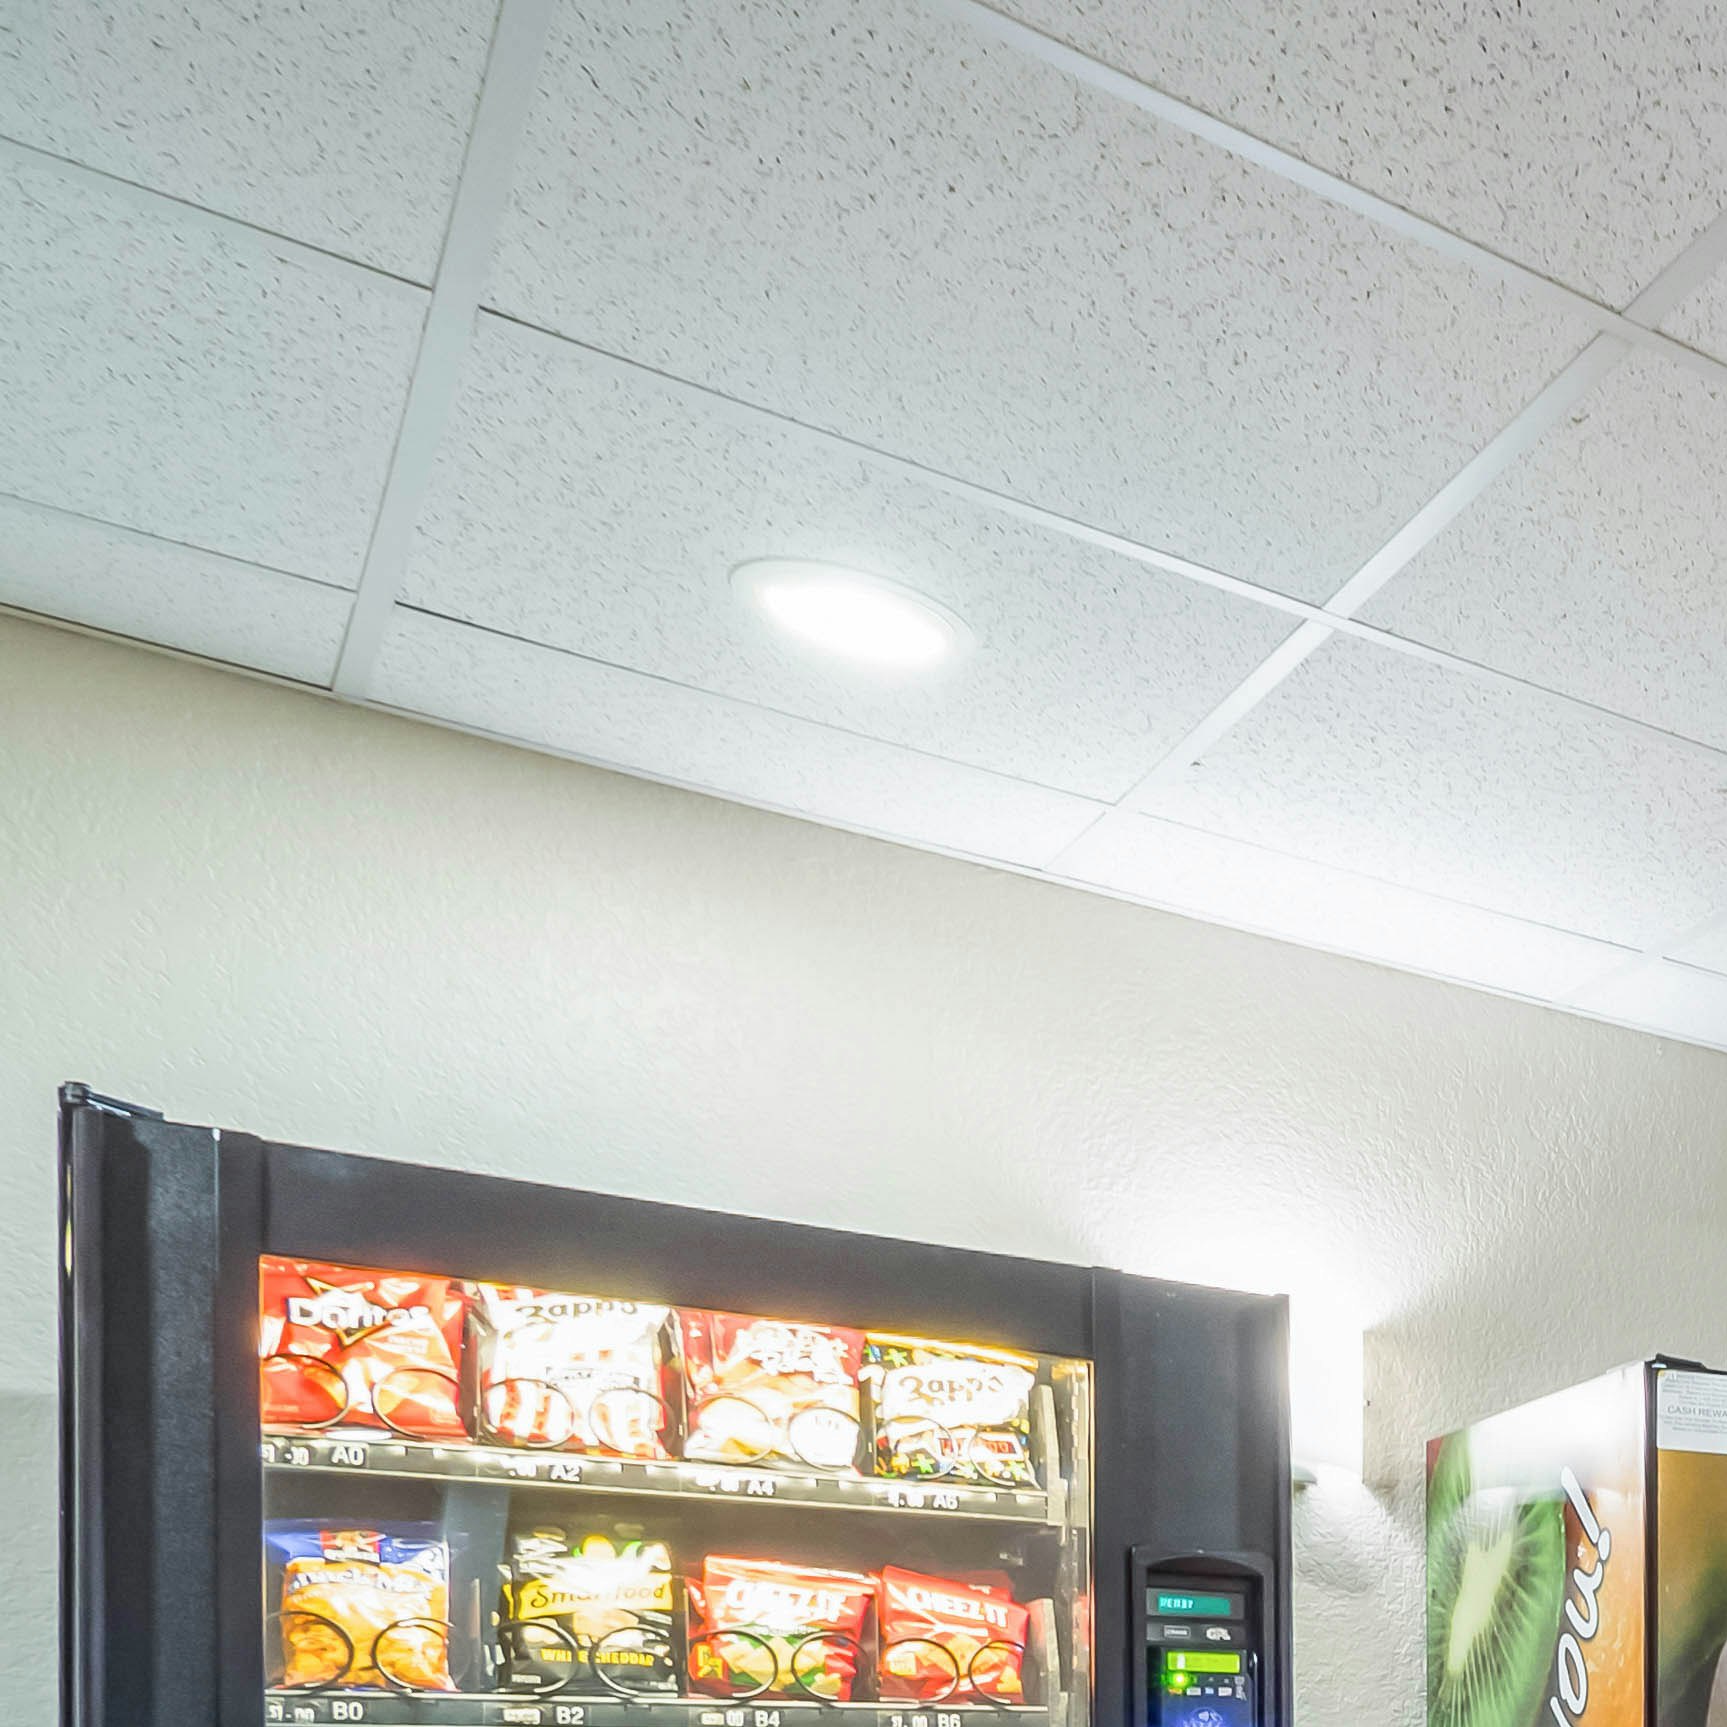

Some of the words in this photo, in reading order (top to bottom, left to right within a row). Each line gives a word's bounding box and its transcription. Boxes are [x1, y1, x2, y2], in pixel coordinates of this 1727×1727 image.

[549, 1464, 582, 1483] A2
[528, 1582, 666, 1609] Smafood
[540, 1646, 589, 1664] WHIE
[332, 1701, 364, 1721] B0
[555, 1706, 585, 1726] B2
[754, 1709, 781, 1727] B4
